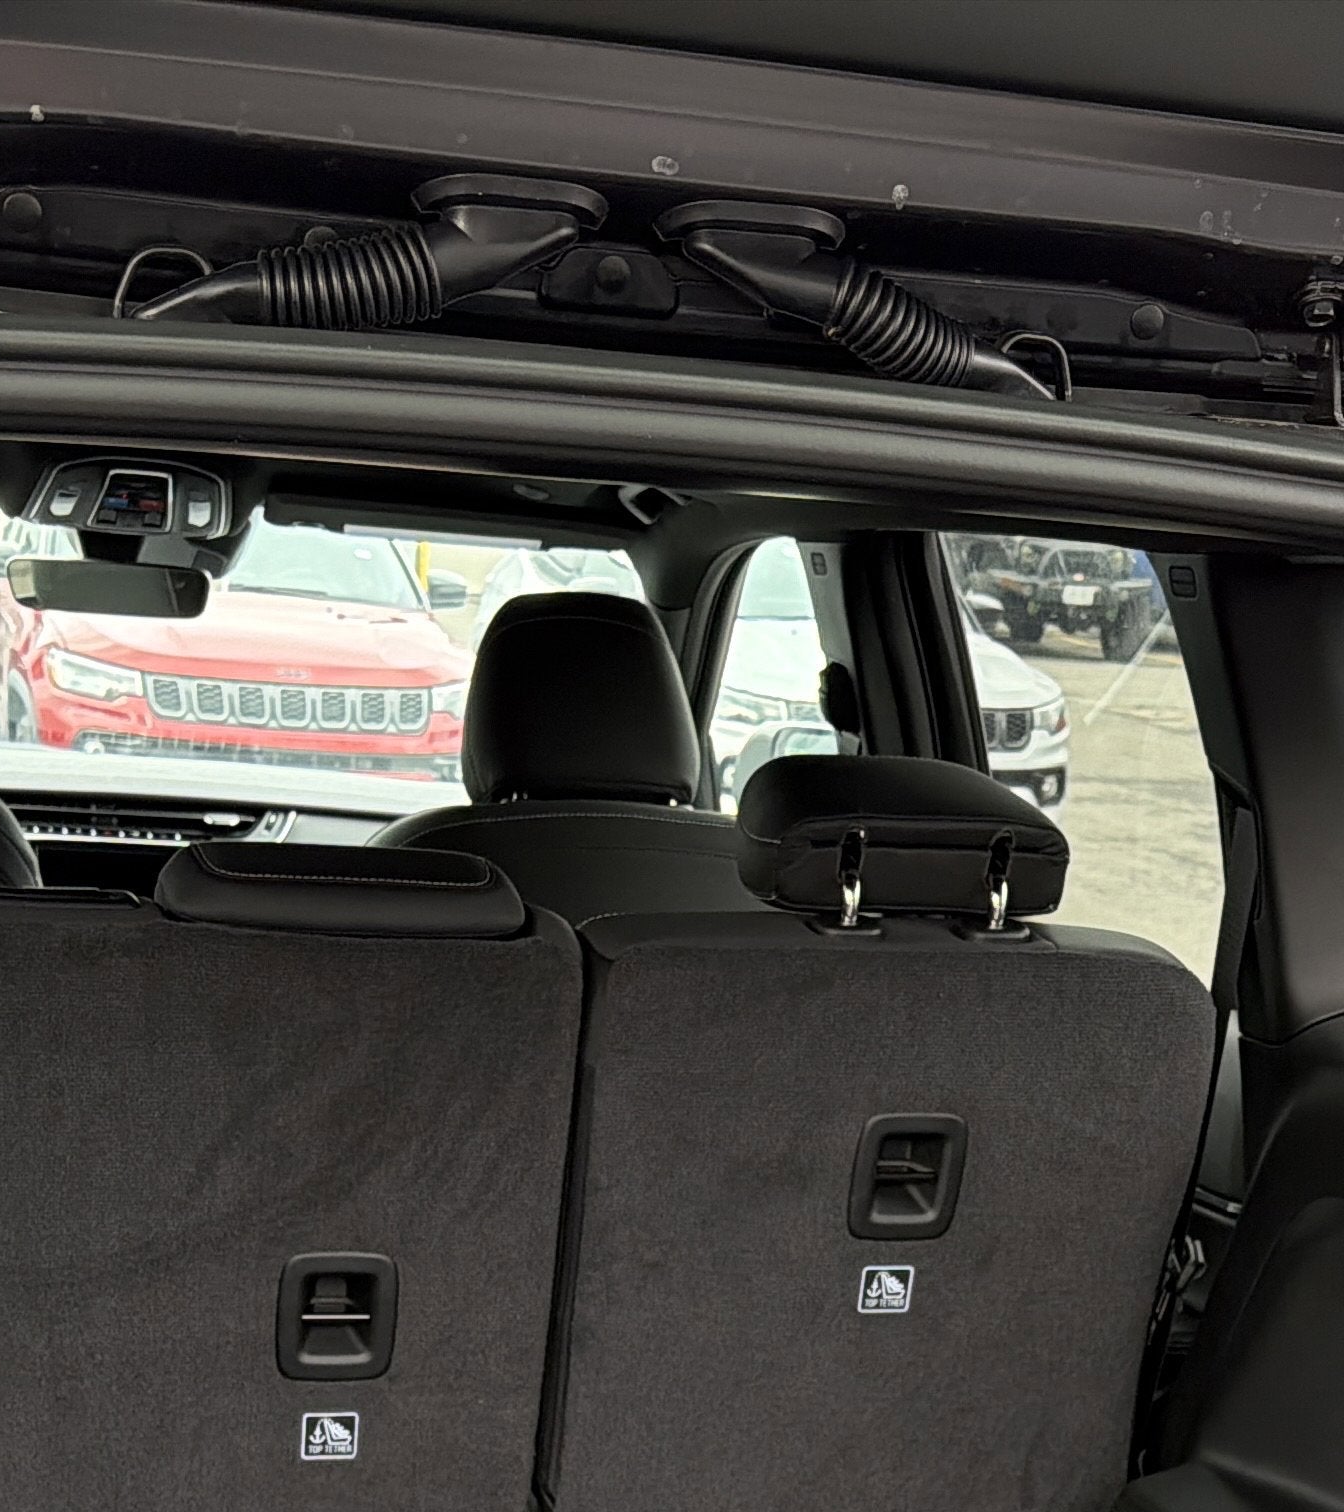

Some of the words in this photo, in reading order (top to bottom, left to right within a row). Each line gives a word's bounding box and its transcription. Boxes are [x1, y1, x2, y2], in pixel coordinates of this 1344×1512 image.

[864, 1299, 879, 1308] TOP
[879, 1298, 905, 1308] TETHER
[308, 1444, 323, 1454] TOP
[324, 1444, 353, 1454] TETHER
